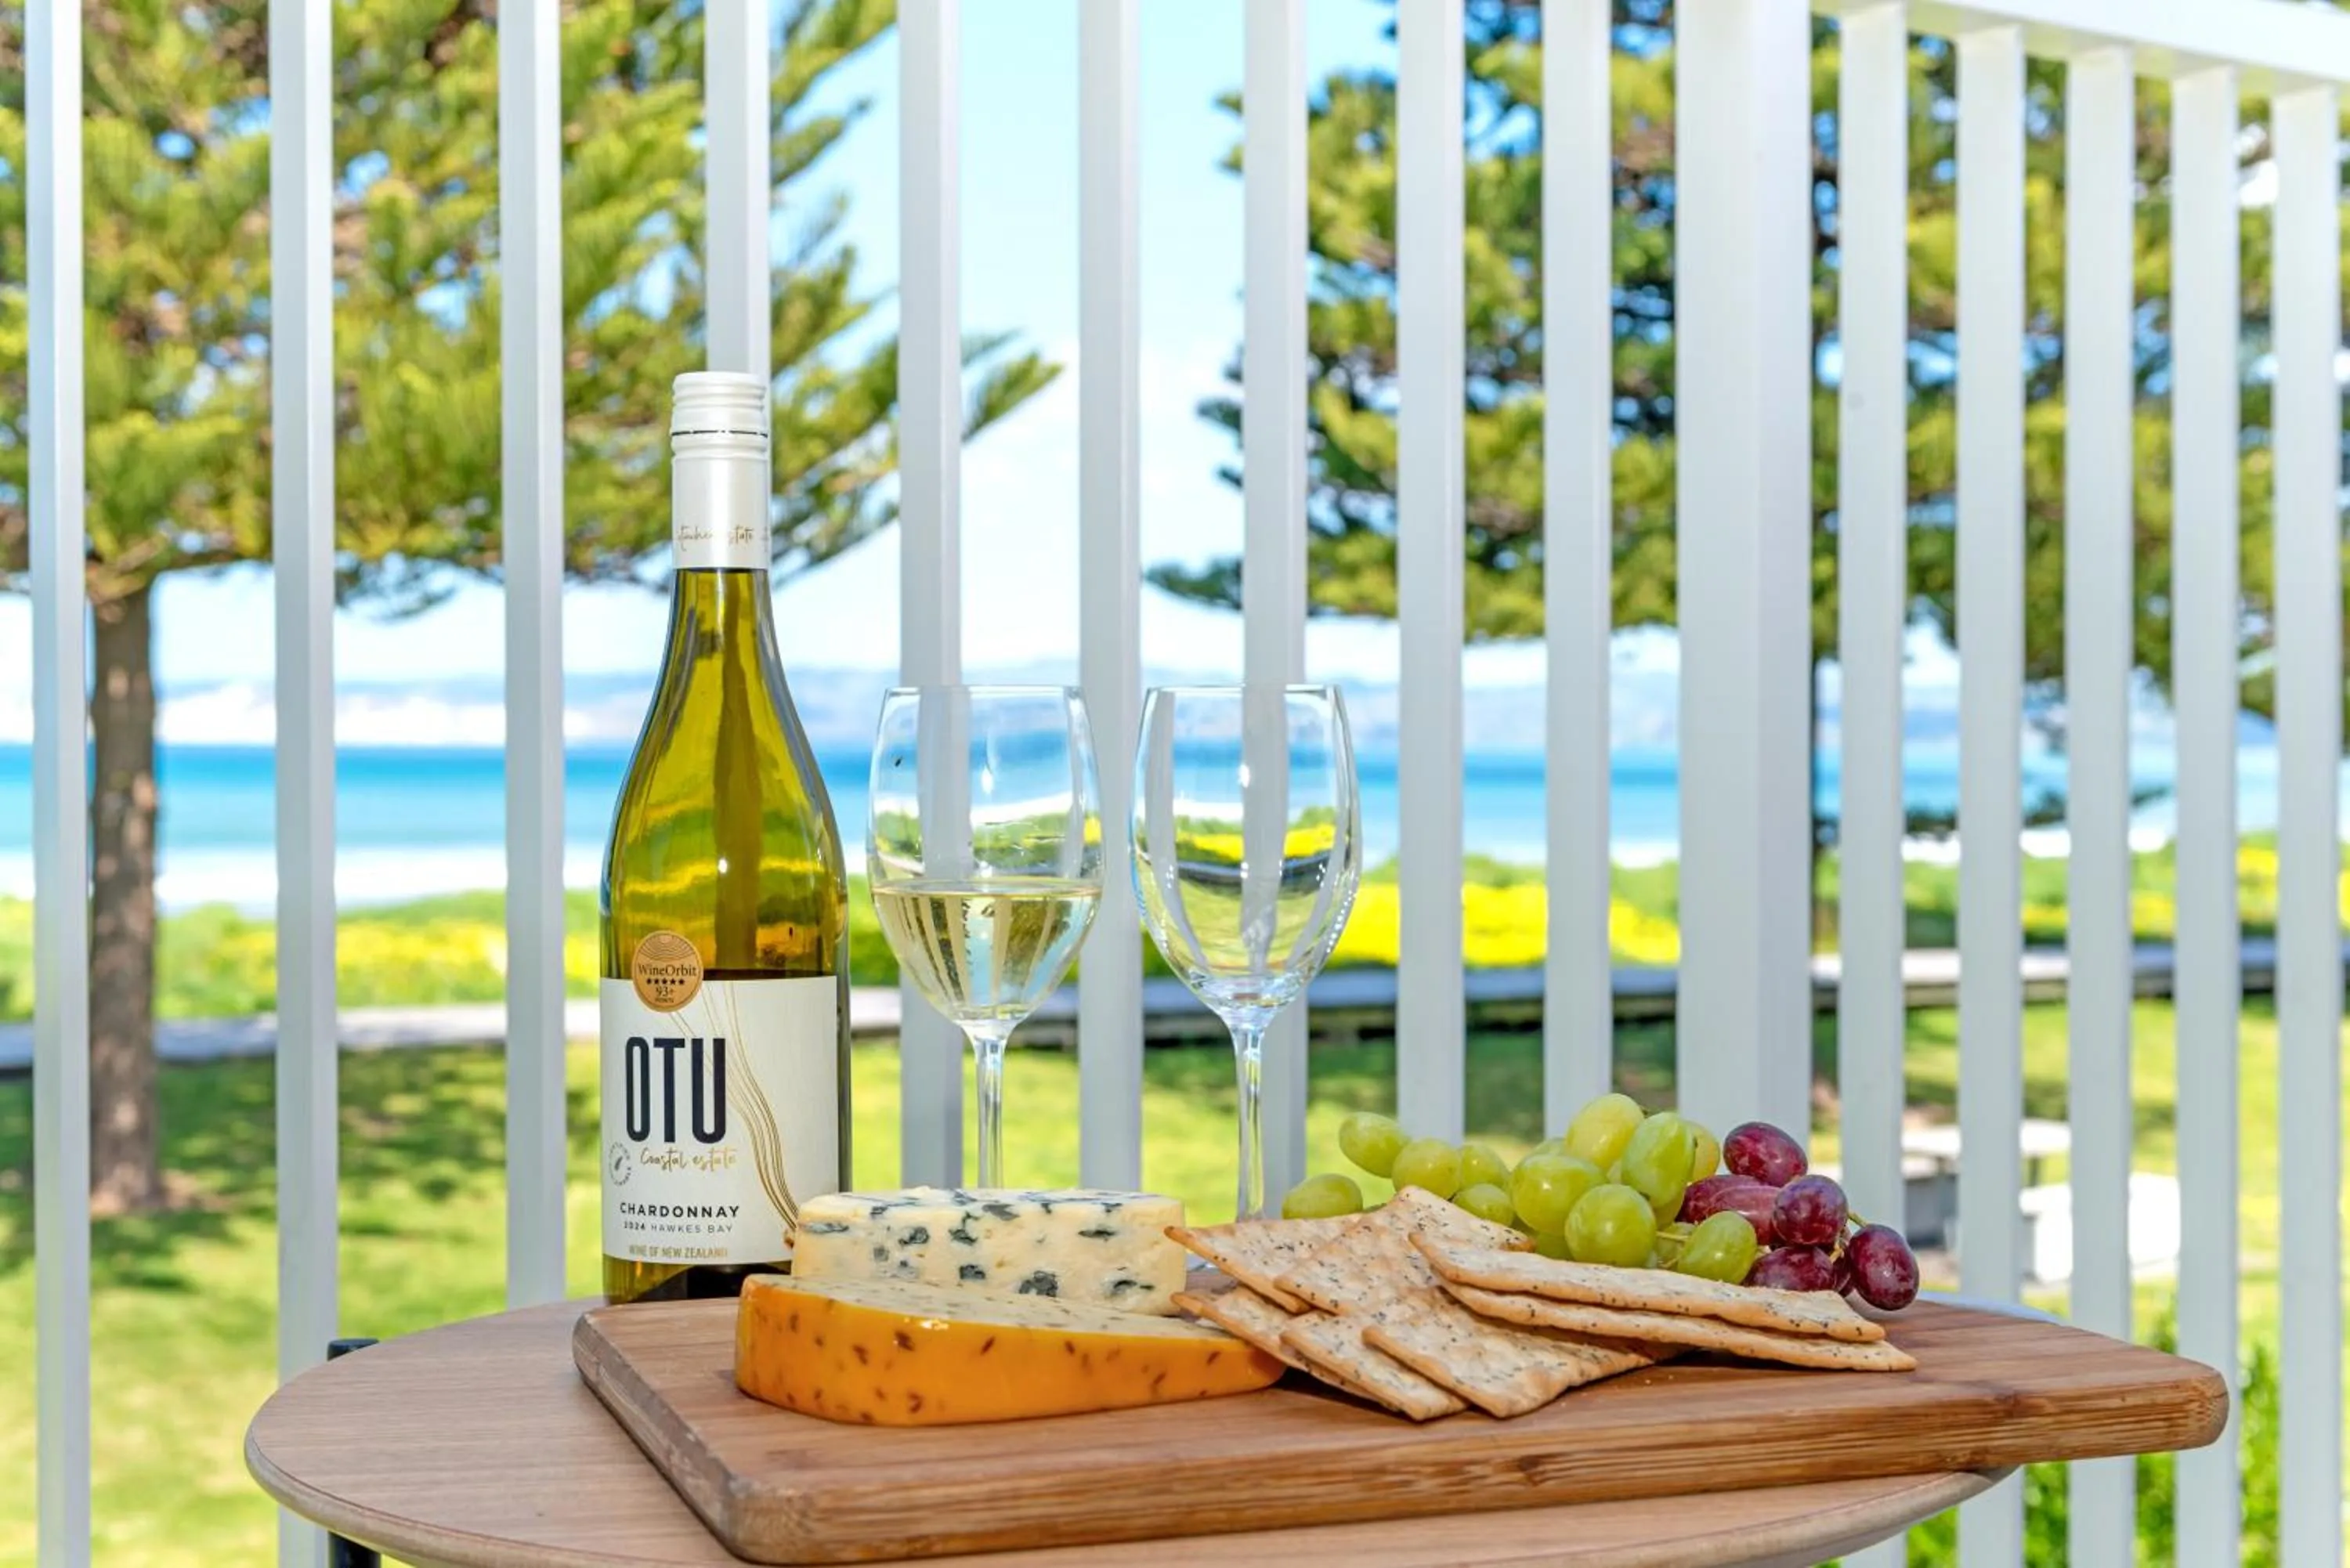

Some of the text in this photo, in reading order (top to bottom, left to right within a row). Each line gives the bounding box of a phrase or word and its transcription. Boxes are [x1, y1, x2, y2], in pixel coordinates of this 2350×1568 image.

[638, 963, 697, 977] WineOrbit
[625, 1036, 726, 1143] OTU
[640, 1147, 687, 1172] Coastal
[692, 1146, 737, 1172] estate
[620, 1201, 739, 1218] CHARDONNAY
[651, 1224, 702, 1234] HAWKES
[707, 1224, 733, 1234] BAY
[661, 1247, 682, 1258] NEW
[684, 1247, 728, 1258] ZEALAND
